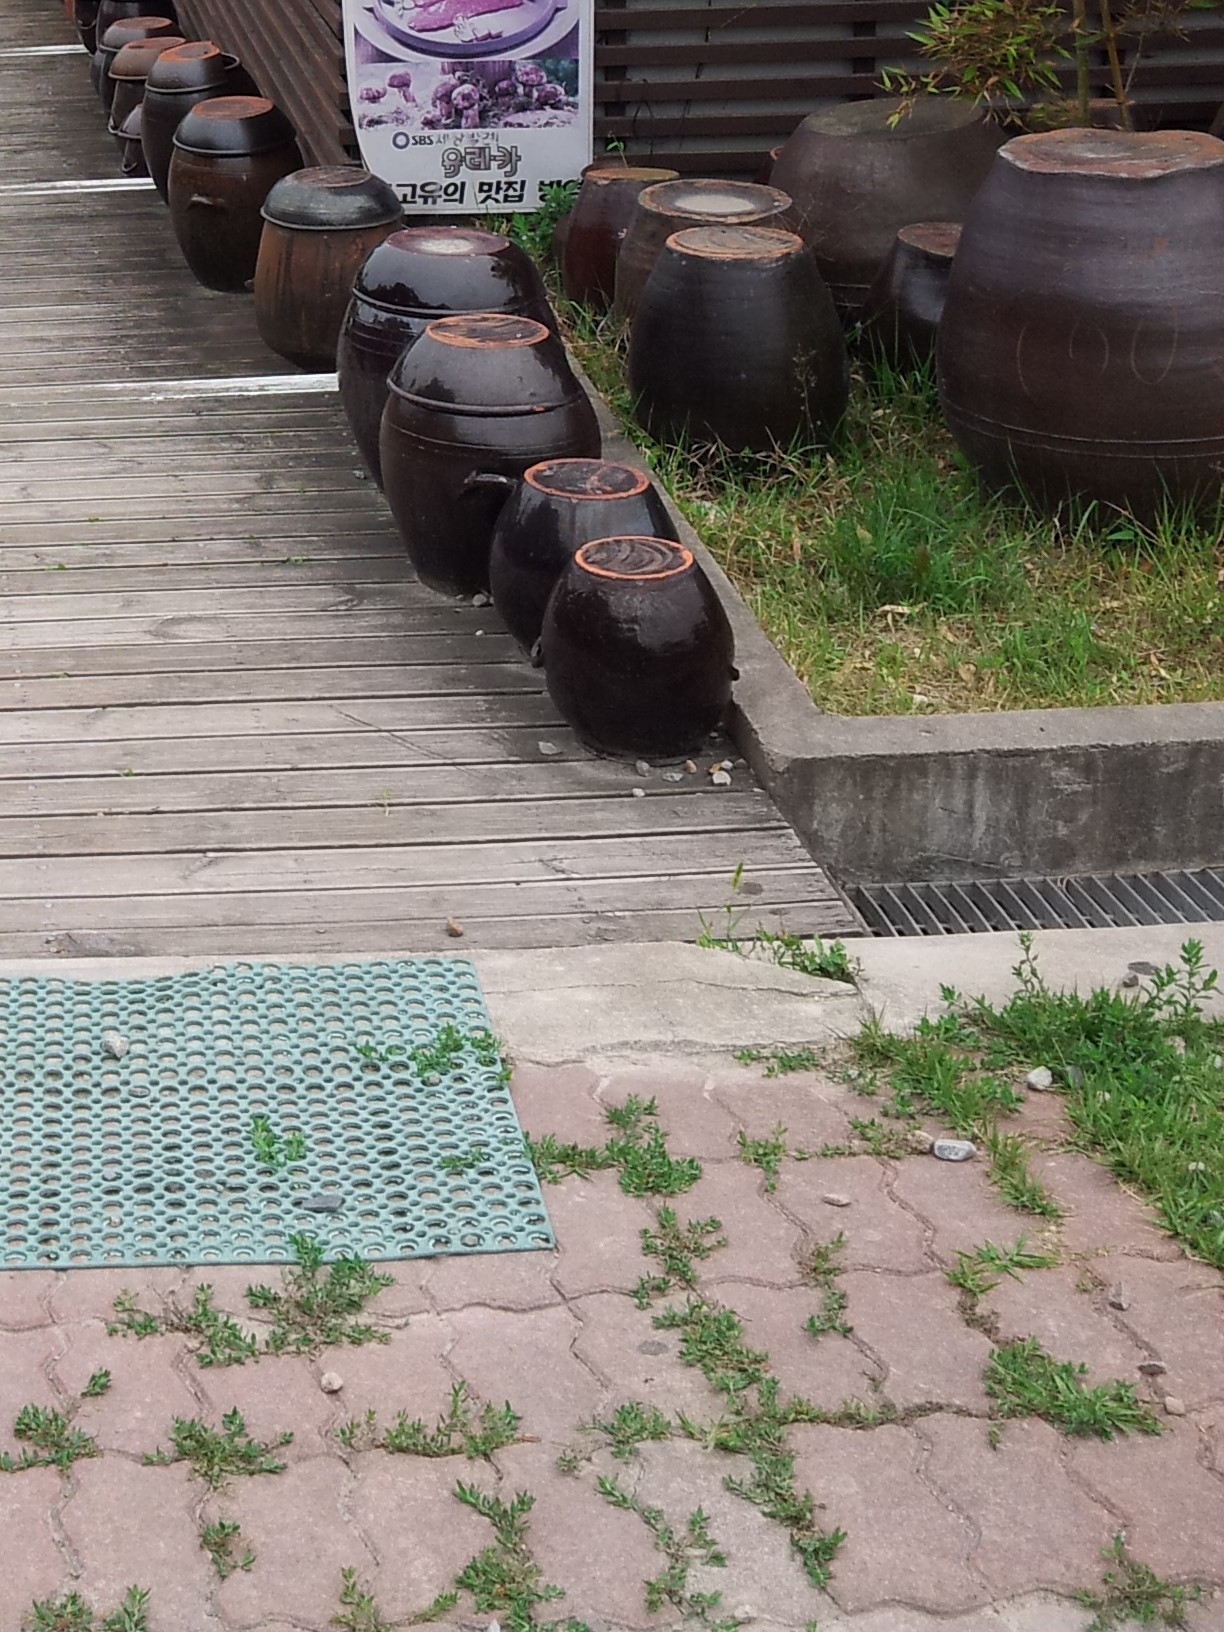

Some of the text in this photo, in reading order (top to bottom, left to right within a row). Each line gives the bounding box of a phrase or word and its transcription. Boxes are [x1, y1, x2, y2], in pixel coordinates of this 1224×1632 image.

[411, 134, 434, 146] SBS
[441, 145, 521, 178] 유레카
[386, 180, 466, 205] 고유의
[478, 179, 526, 205] 맛집
